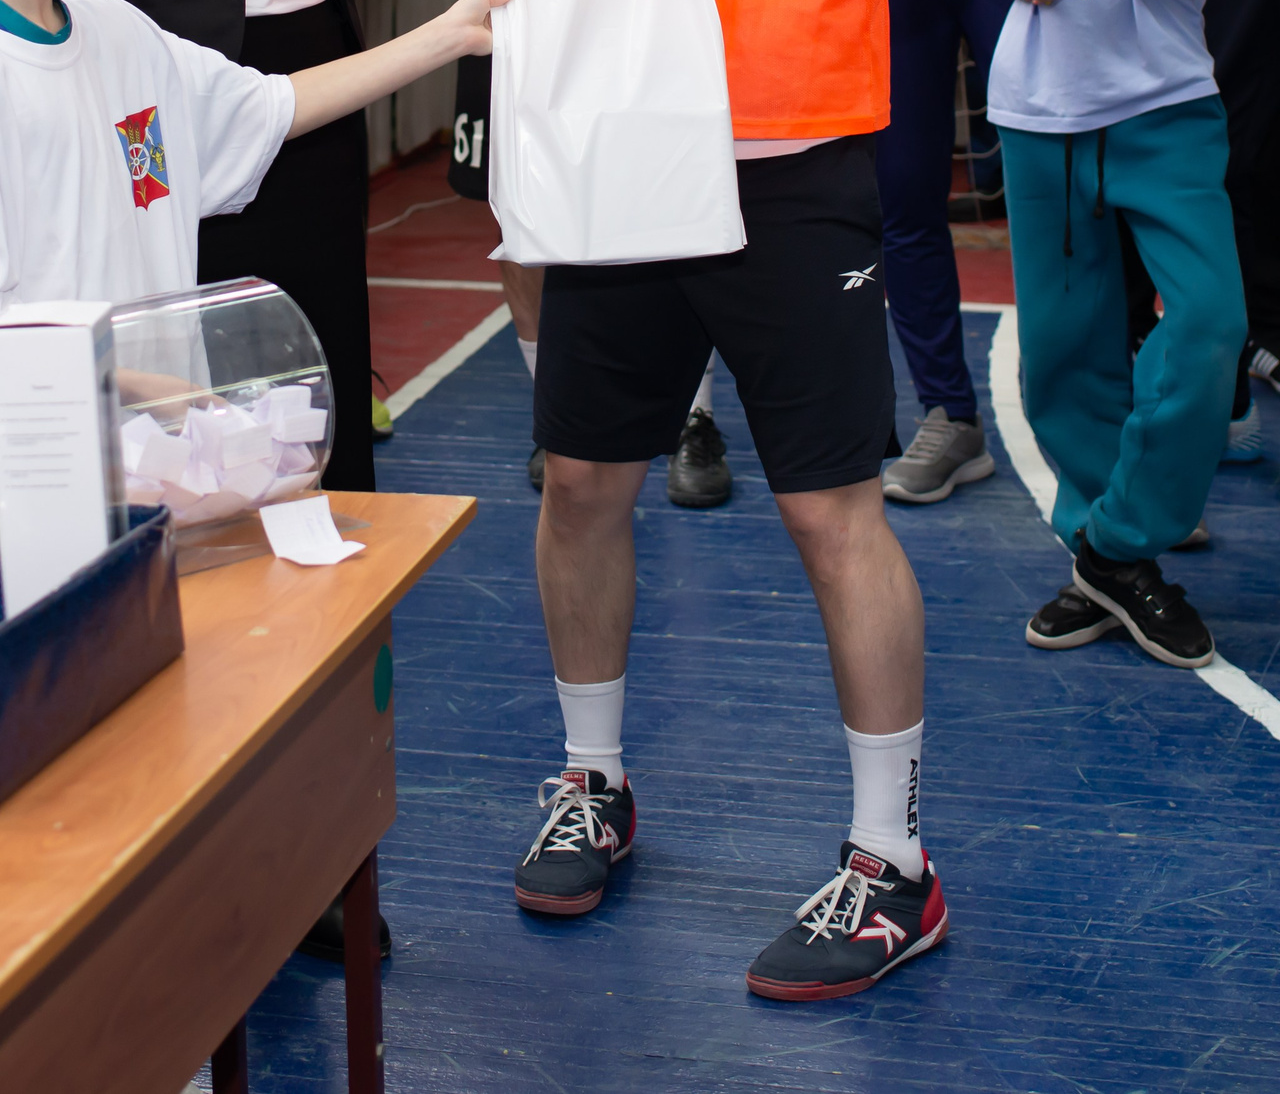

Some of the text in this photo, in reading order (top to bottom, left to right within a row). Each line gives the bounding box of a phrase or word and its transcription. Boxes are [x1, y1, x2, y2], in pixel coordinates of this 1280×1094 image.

[454, 113, 484, 169] 61
[907, 757, 919, 840] ATHLEX
[854, 855, 880, 869] KELME
